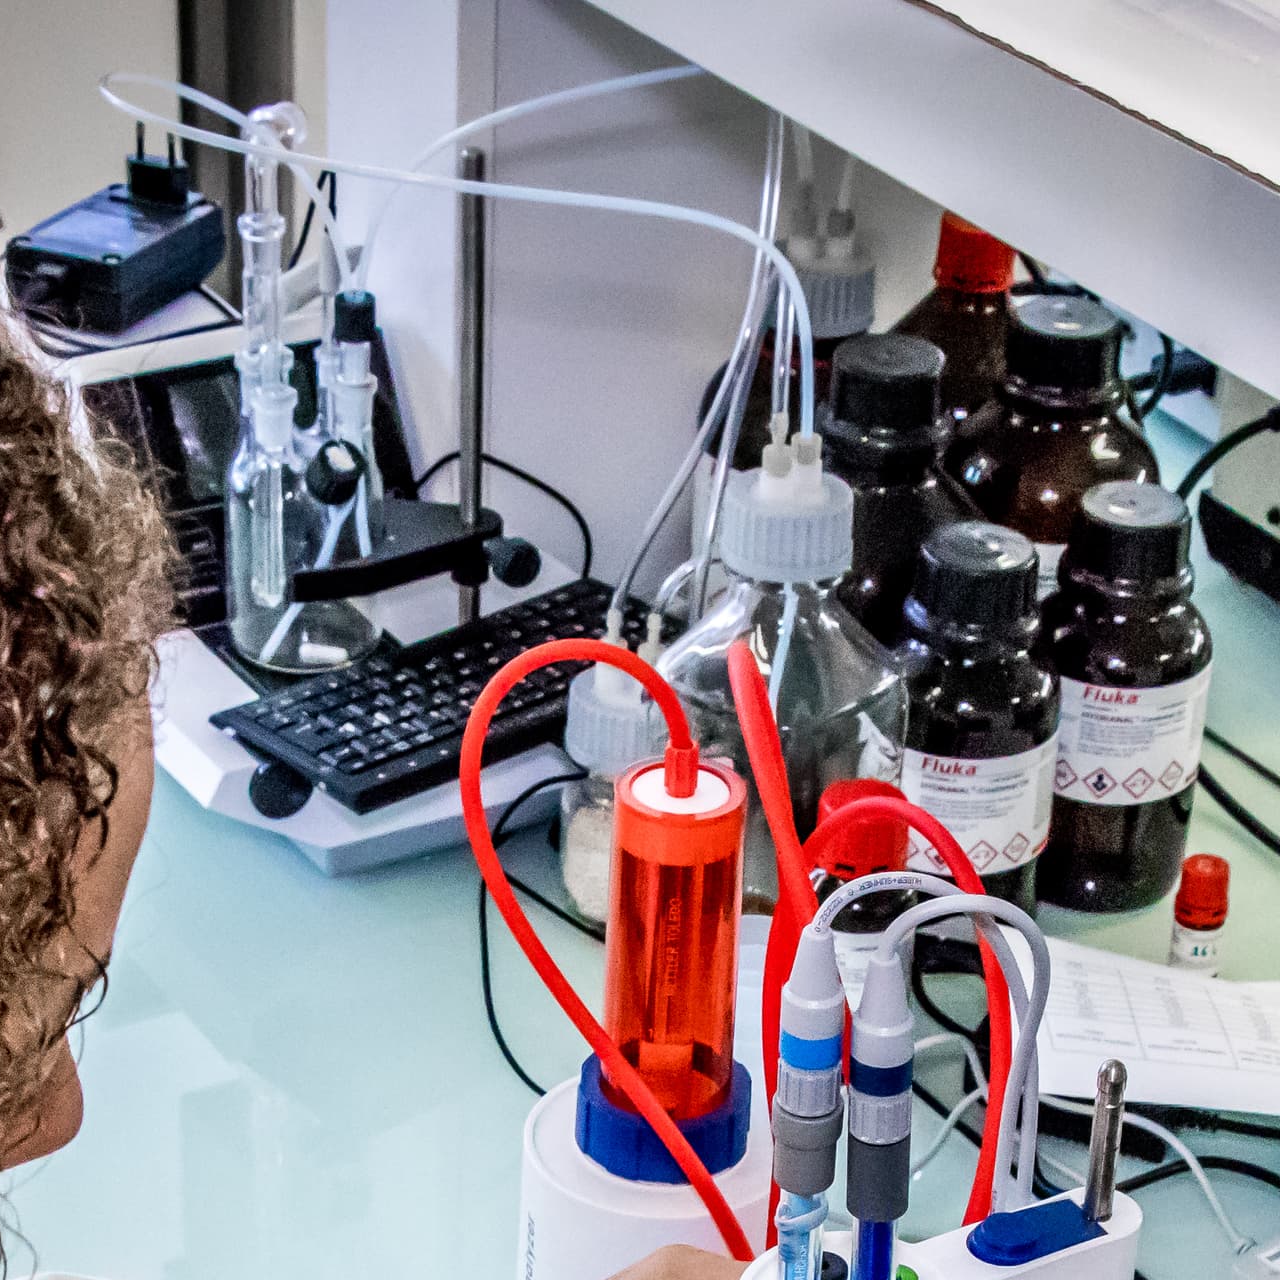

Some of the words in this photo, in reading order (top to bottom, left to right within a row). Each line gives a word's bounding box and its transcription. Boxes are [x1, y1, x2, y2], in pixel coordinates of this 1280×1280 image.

[1083, 685, 1140, 705] Fluka
[922, 756, 977, 776] Fluka
[667, 898, 682, 942] TOLEDO
